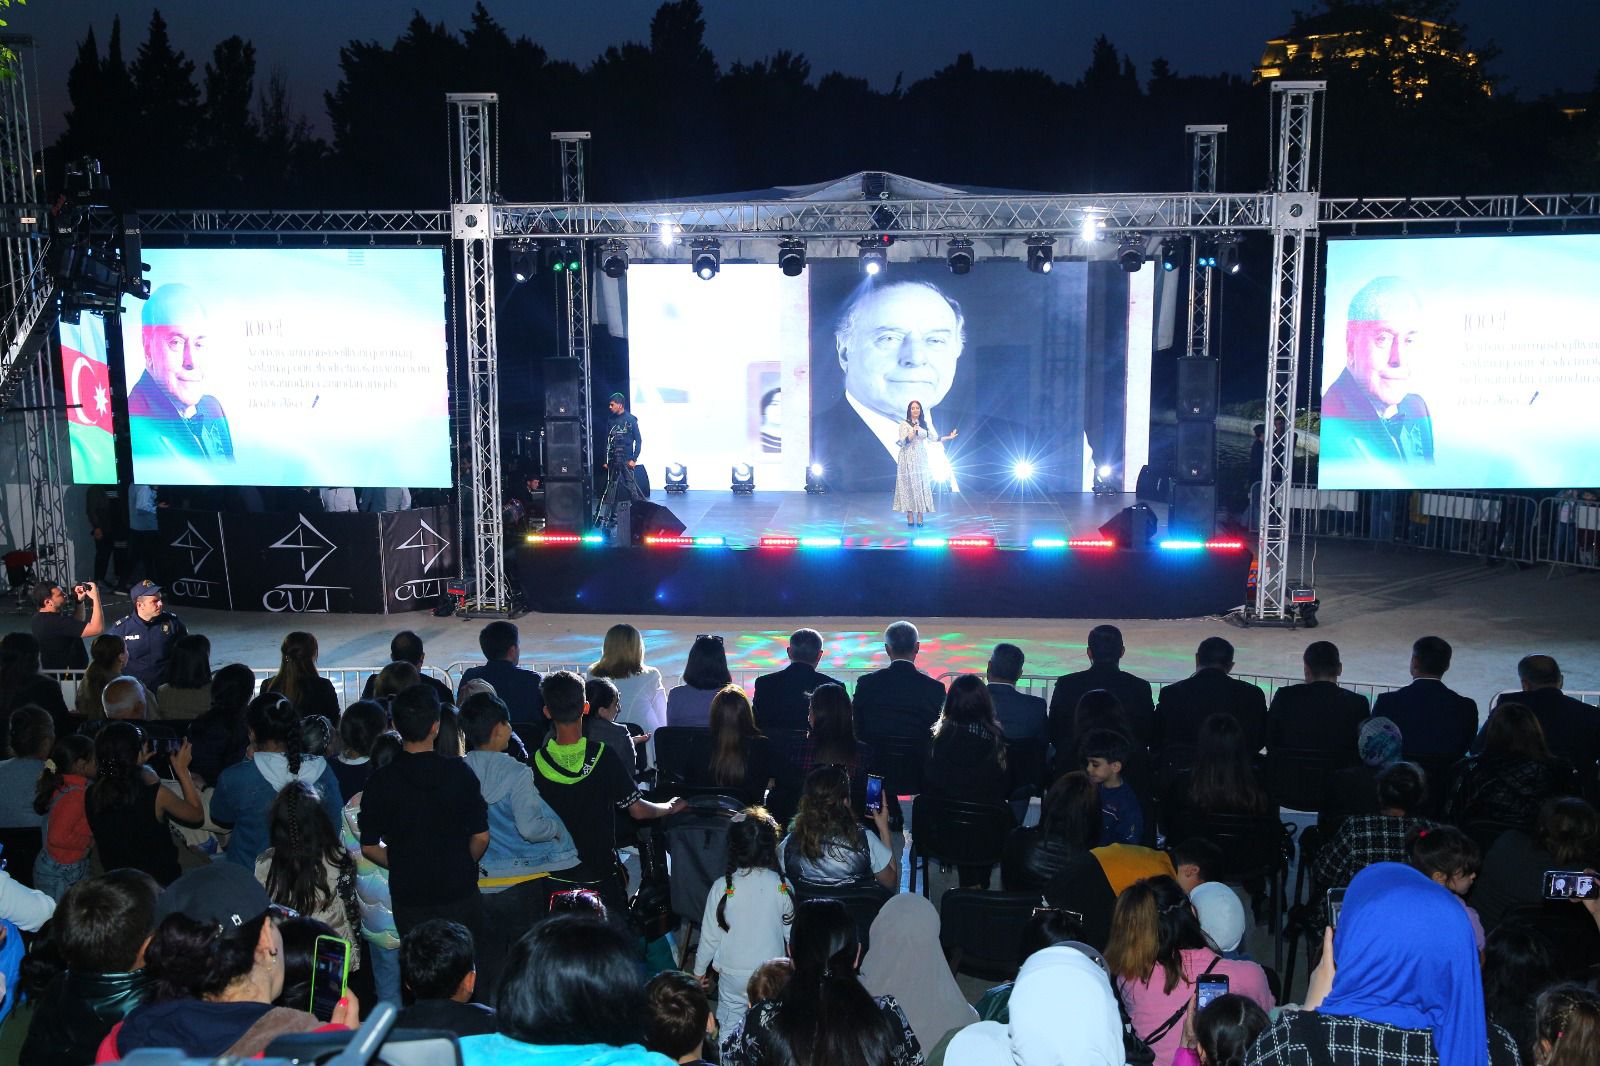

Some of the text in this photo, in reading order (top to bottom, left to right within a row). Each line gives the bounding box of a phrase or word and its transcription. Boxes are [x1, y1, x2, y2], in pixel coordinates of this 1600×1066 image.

[172, 577, 220, 599] CULT
[262, 583, 352, 613] CULT
[393, 576, 456, 601] CULT
